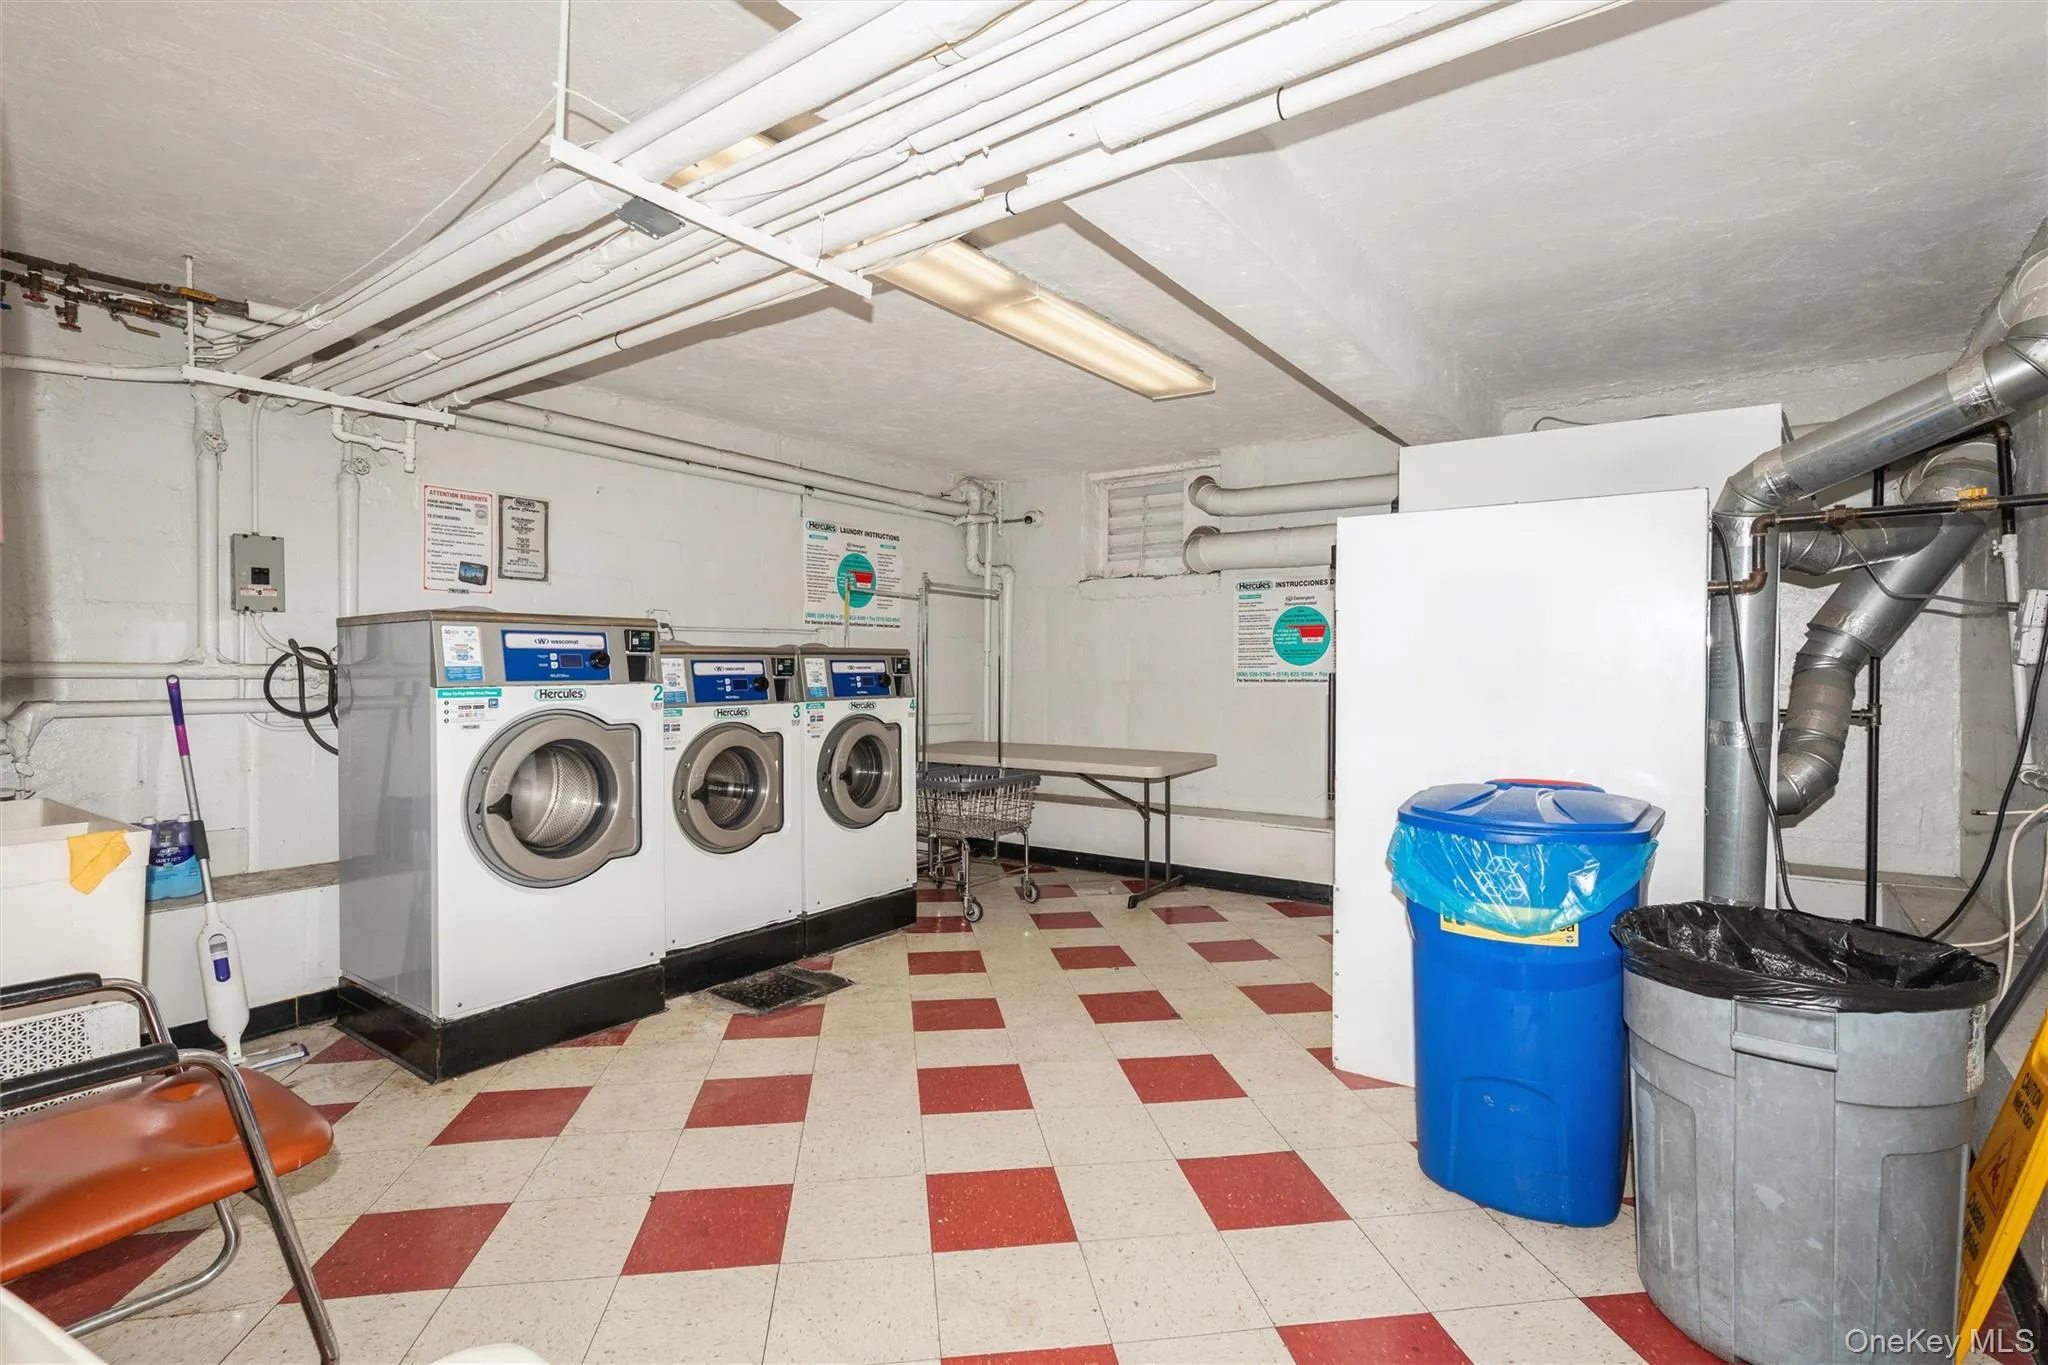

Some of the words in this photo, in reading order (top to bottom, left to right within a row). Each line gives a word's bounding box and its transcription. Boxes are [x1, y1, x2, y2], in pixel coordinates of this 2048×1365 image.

[429, 490, 458, 498] ATTENTION
[460, 494, 488, 502] RESIDENTS
[808, 521, 836, 532] Hercules
[840, 528, 863, 536] LAUNDRY
[864, 532, 900, 542] INSTRUCTIONS
[1239, 581, 1270, 590] Hercules
[1275, 579, 1328, 588] INSTRUCCIONES
[540, 689, 583, 699] Hercules
[653, 685, 663, 701] 2
[910, 699, 915, 711] 4
[716, 708, 748, 717] Hercules
[793, 705, 800, 718] 3
[2022, 1072, 2043, 1111] CAUTION
[2020, 1102, 2034, 1130] Floor
